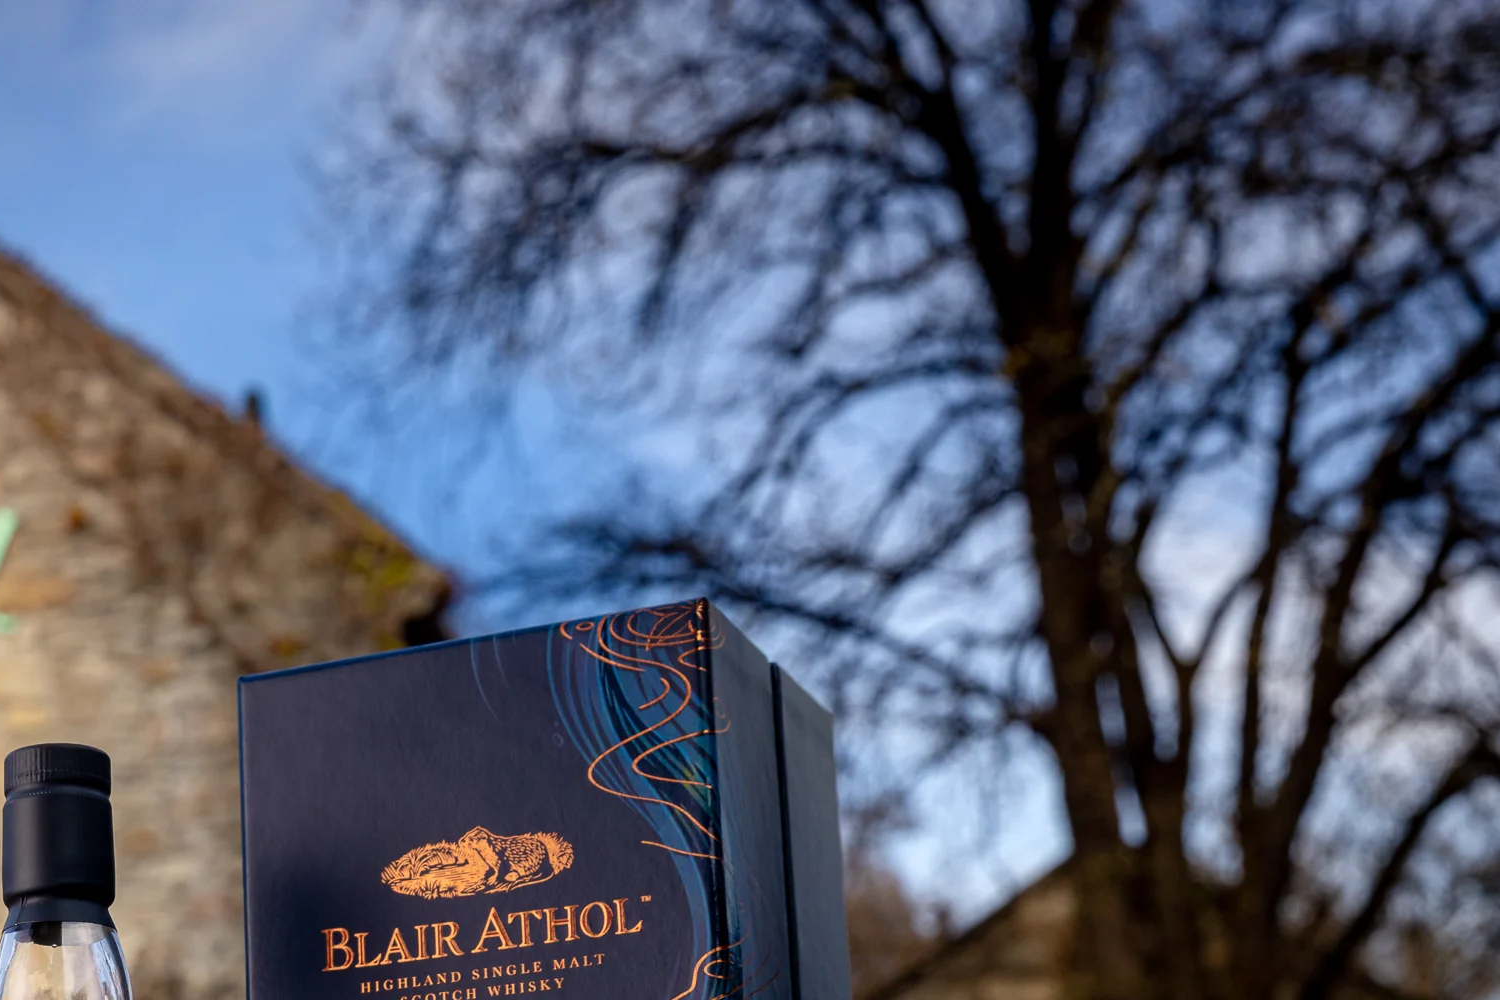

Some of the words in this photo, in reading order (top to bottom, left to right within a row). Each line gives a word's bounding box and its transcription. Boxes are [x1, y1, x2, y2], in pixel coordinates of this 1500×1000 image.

[321, 920, 465, 973] BLAIR
[360, 971, 462, 994] HIGHLAND
[471, 960, 543, 980] SINGLE
[552, 952, 606, 971] MALT
[488, 977, 565, 998] WHISKY
